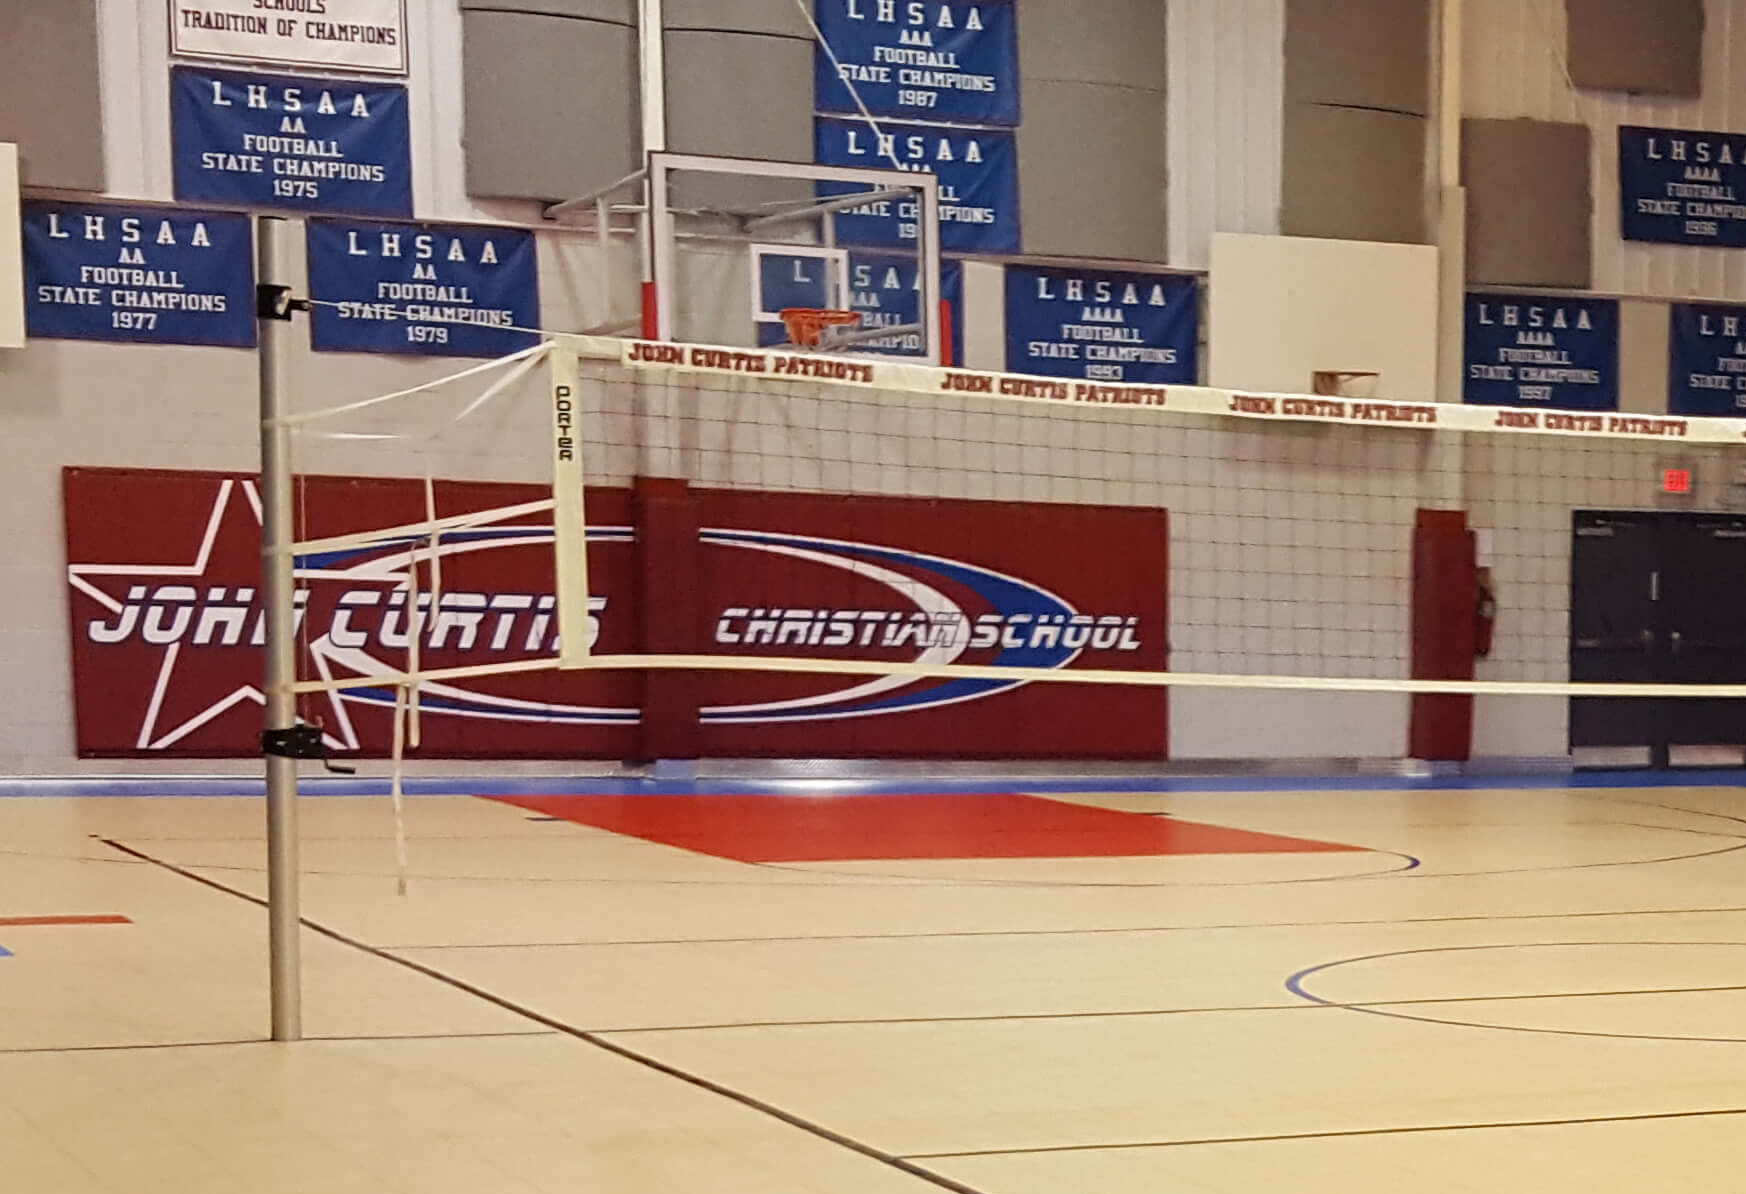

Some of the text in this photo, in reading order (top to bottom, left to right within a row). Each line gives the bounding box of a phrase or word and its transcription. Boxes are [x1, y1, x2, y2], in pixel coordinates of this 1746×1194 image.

[182, 10, 396, 45] TRADITION OF CHAMPIONS
[899, 30, 932, 46] AAA
[873, 46, 960, 68] FOOTBALL
[838, 64, 995, 92] STATE CHAMPIONS
[898, 90, 938, 107] 1987
[280, 116, 306, 134] AA
[244, 134, 343, 157] FOOTBALL
[202, 153, 384, 182] STATE CHAMPIONS
[273, 180, 318, 198] 1975
[1667, 183, 1736, 200] FOOTBALL
[899, 203, 994, 224] CHPIONS
[1638, 199, 1681, 215] STATE
[119, 248, 145, 264] AA
[81, 266, 184, 288] FOOTBALL
[413, 263, 437, 280] AA
[38, 286, 226, 312] STATE CHAMPIONS
[378, 283, 473, 303] FOOTBALL
[112, 311, 157, 330] 1977
[338, 302, 513, 326] STATE CHAMPIONS
[408, 326, 448, 344] 1979
[1062, 324, 1144, 343] FOOTBALL
[628, 343, 874, 382] JOHN CURTIS PATRIOTS
[1029, 342, 1176, 363] STATE CHAMPIONS
[1499, 347, 1572, 365] FOOTBALL
[1470, 364, 1600, 384] STATE CHAMPIONS
[1689, 374, 1732, 390] STATE
[941, 372, 1168, 405] JOHN CURTIS PATRIOTS
[1229, 395, 1437, 423] JOHN CURTIS PATRIOTS
[556, 386, 573, 461] PORTER
[1495, 411, 1688, 437] JOHN CURTIS PATRIOTS
[715, 608, 1142, 650] CHRISTIAN SCHOOL
